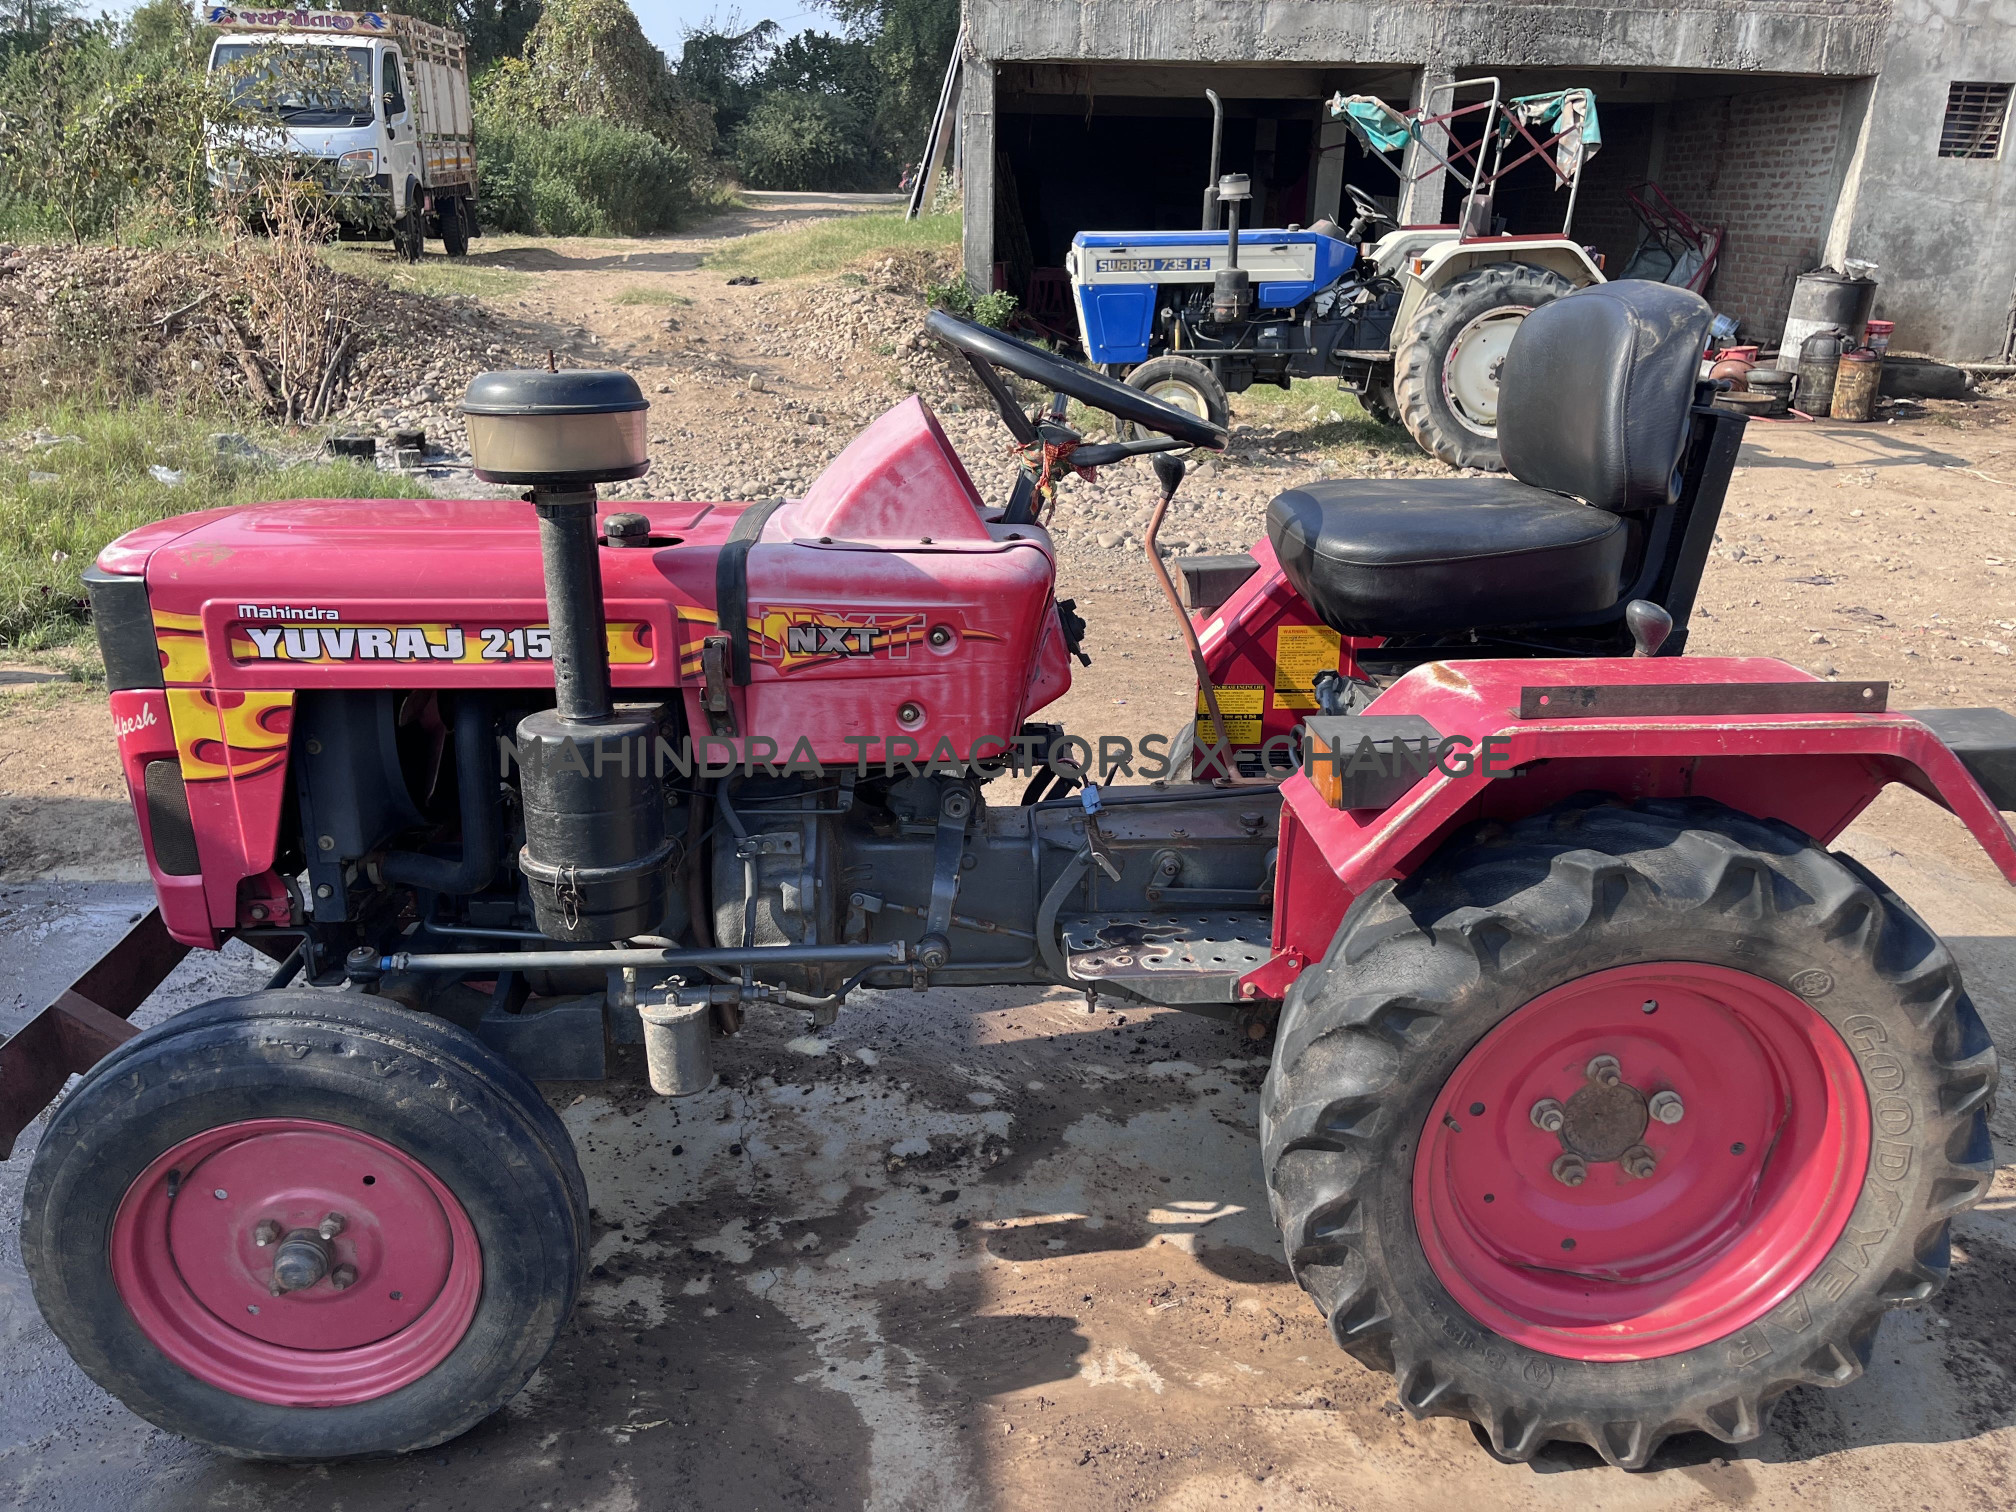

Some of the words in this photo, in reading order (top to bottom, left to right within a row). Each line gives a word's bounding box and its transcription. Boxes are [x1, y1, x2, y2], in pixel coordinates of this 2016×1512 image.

[1160, 258, 1187, 271] 735
[1190, 258, 1209, 270] FE
[237, 604, 340, 620] Mahindra
[244, 627, 465, 659] YUVRAJ
[480, 627, 553, 660] 215
[787, 626, 880, 654] NXT
